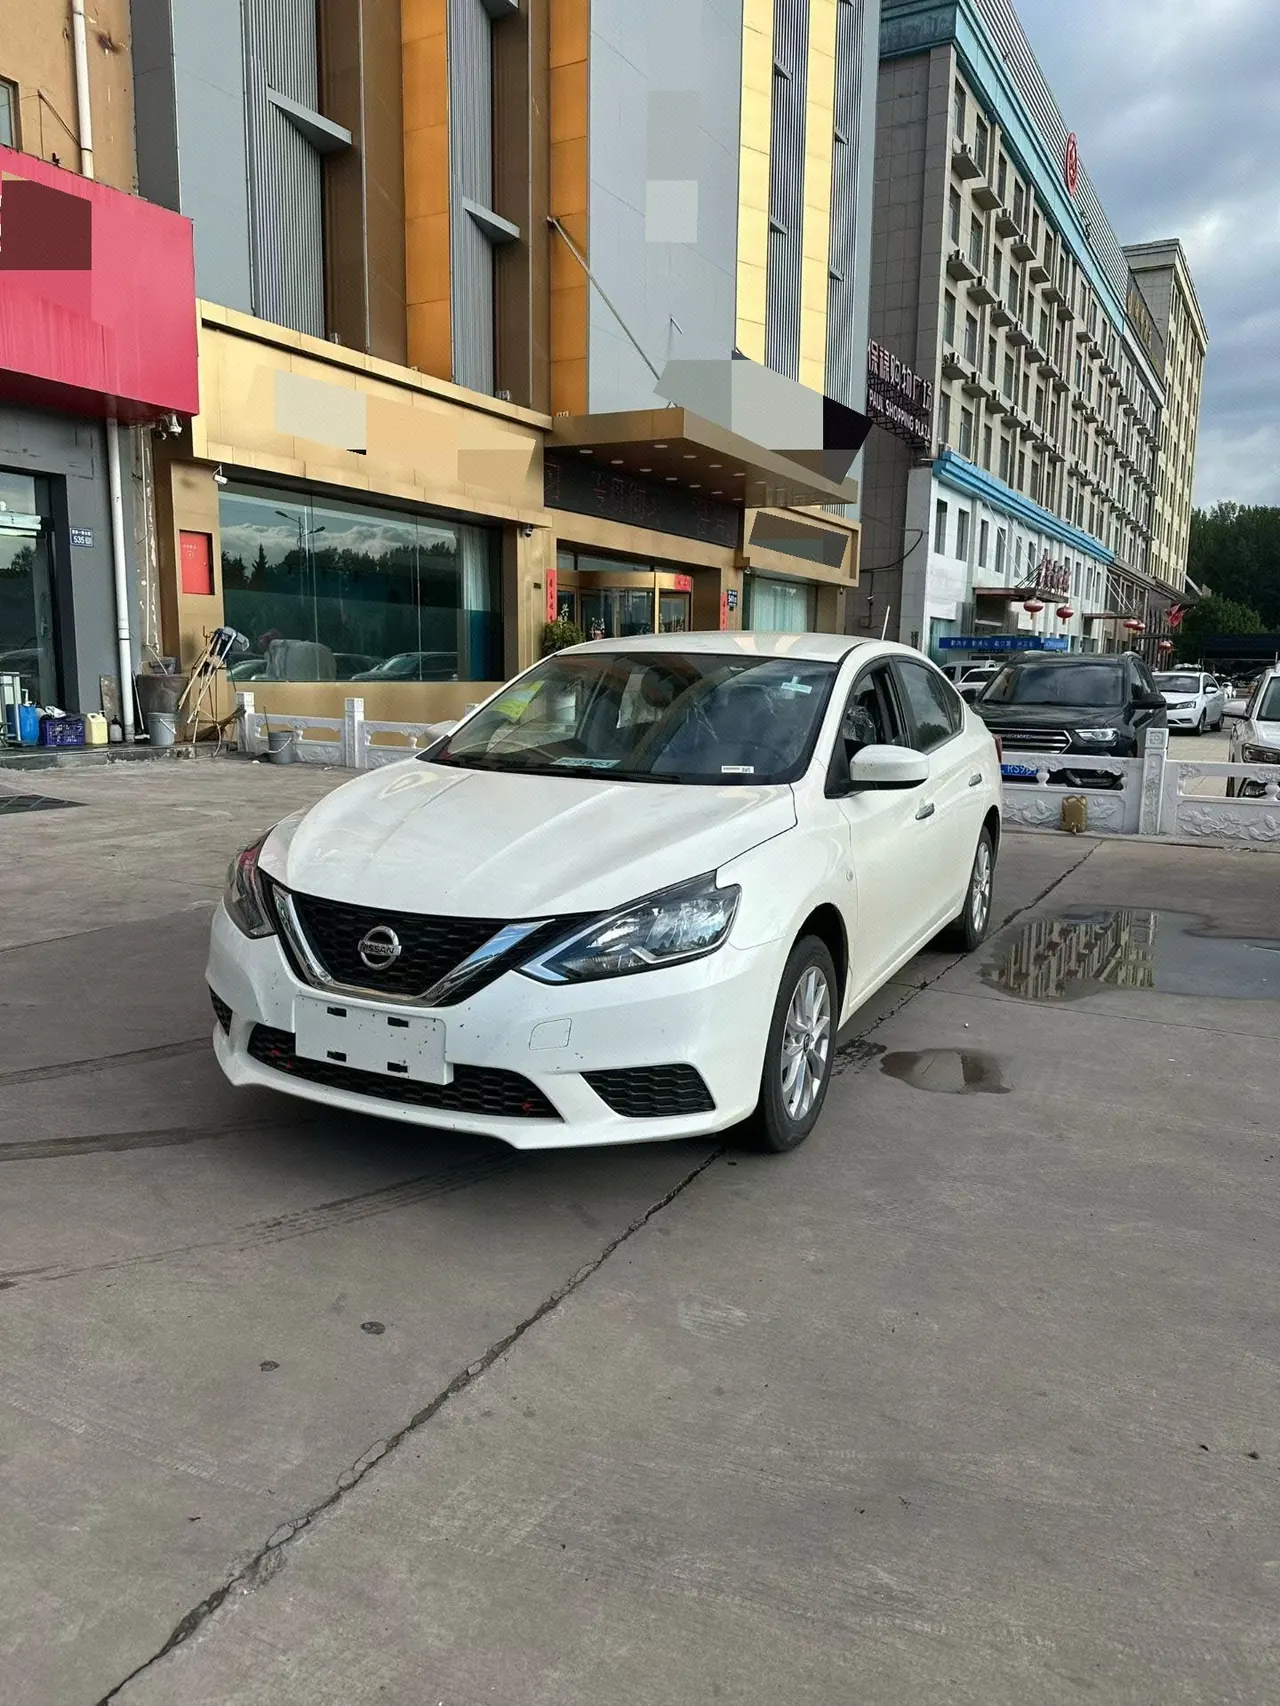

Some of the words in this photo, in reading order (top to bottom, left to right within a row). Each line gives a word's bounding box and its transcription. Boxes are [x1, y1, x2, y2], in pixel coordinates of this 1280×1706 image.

[869, 388, 884, 412] PAUL
[885, 399, 914, 431] SHOPPING
[915, 418, 931, 440] PLAZA
[361, 942, 395, 953] NISSAN
